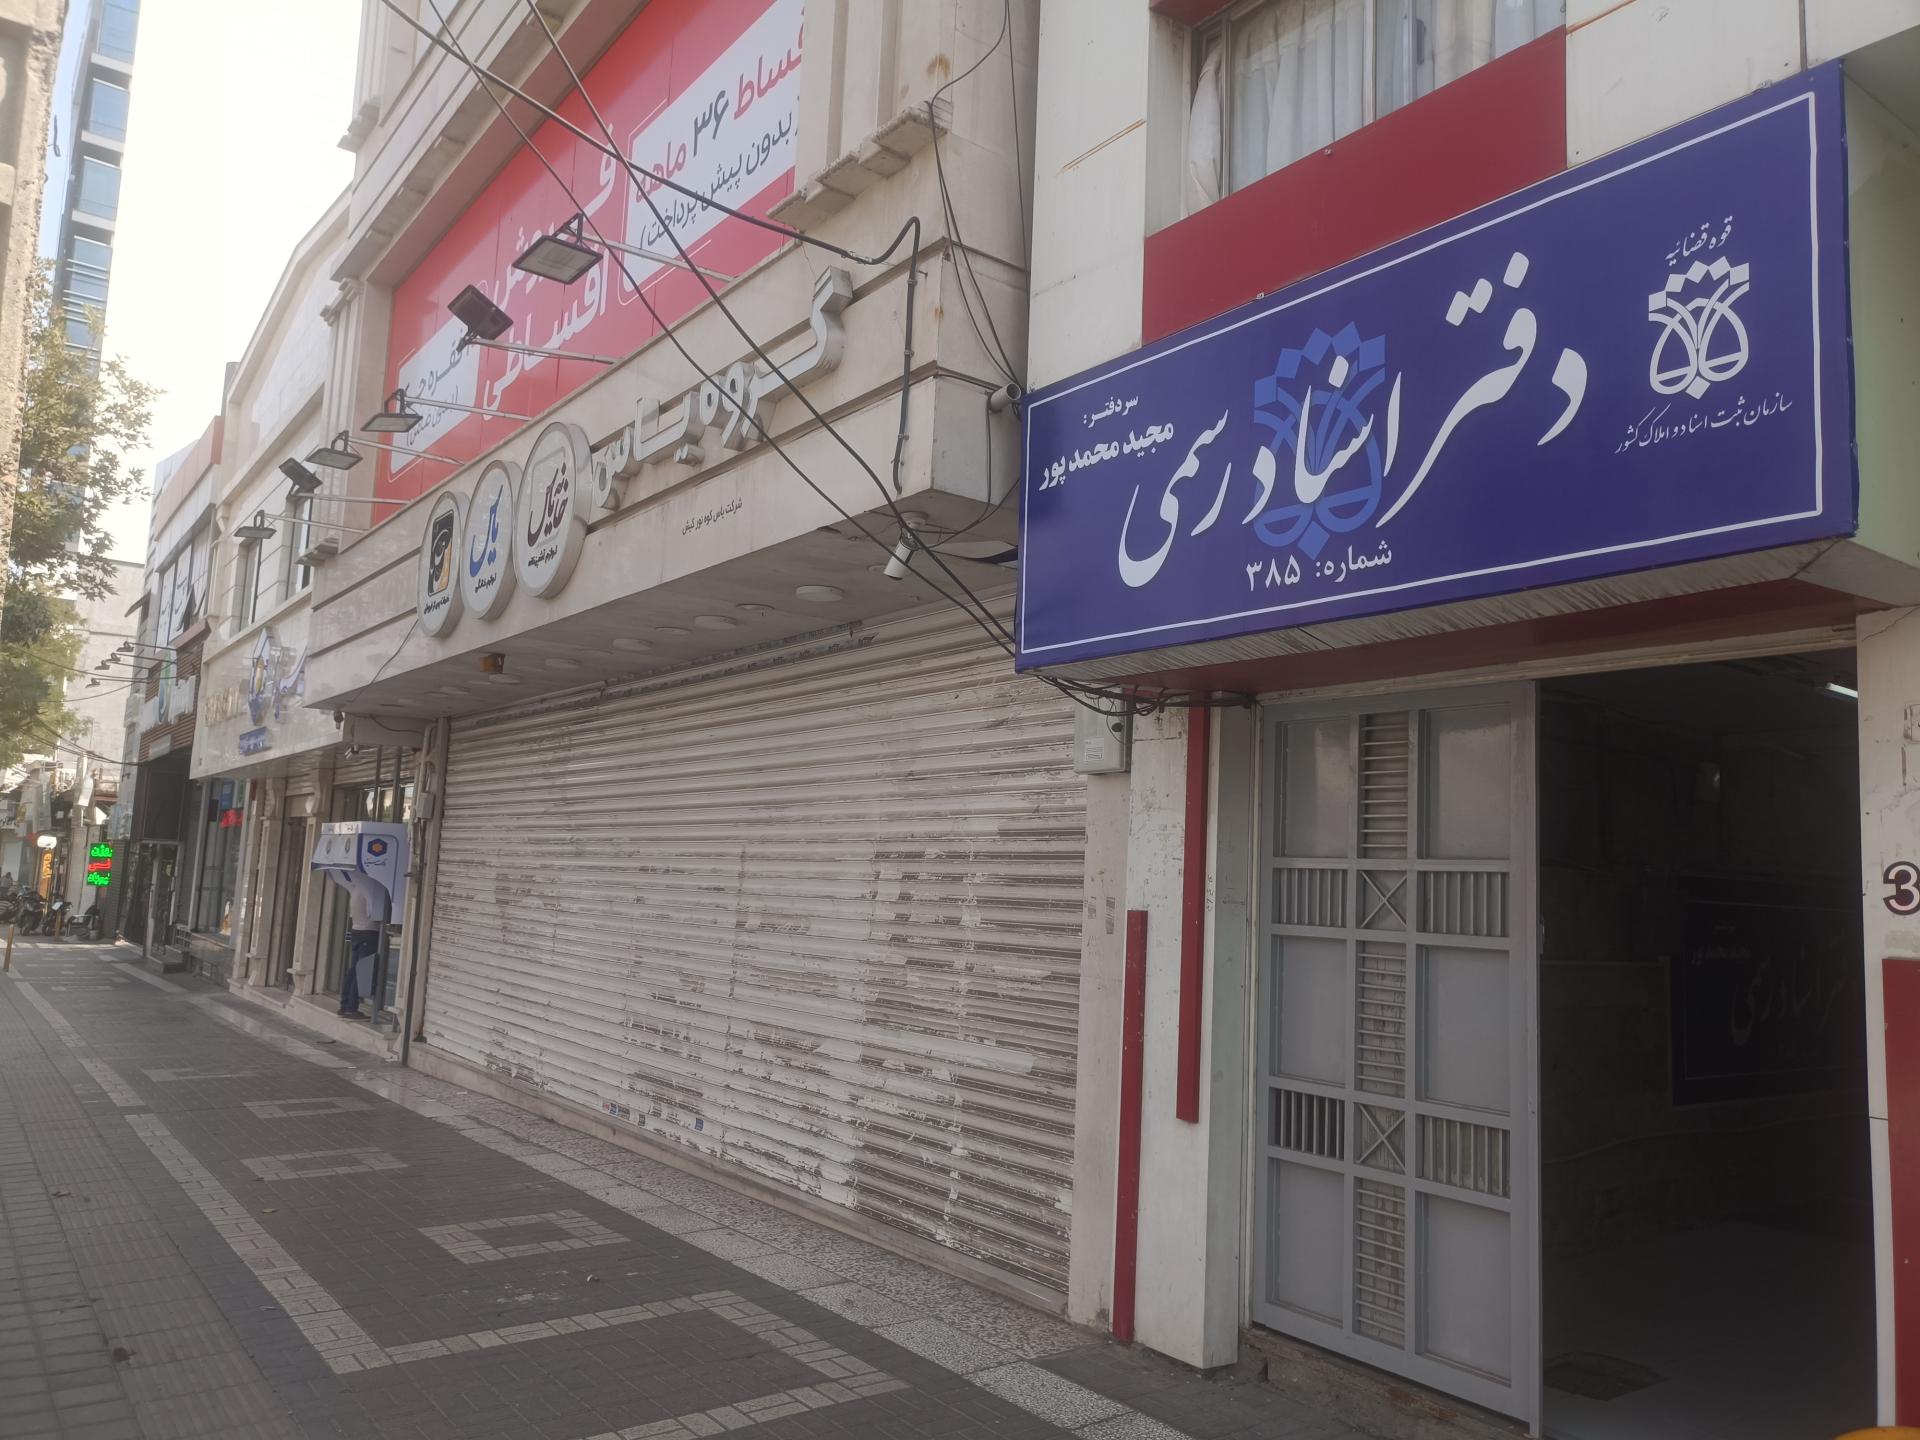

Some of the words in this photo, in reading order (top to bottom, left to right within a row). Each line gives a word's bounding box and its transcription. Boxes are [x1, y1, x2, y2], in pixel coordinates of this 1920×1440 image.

[693, 90, 729, 156] ۳۶
[746, 104, 797, 175] بدون
[701, 153, 742, 211] پیش
[1709, 216, 1733, 249] قوه
[484, 245, 610, 421] اقساطی
[701, 265, 852, 451] گروه
[1377, 251, 1588, 528] دفتر
[1711, 395, 1745, 427] ثبت
[1743, 392, 1793, 425] سازمان
[1123, 422, 1174, 458] مجید
[1242, 355, 1401, 525] اسناد
[1615, 407, 1657, 454] کشور
[1639, 403, 1672, 447] املاک
[1672, 427, 1680, 438] و
[1681, 414, 1708, 436] اسناد
[594, 390, 704, 511] یاس
[703, 509, 713, 525] کوه
[713, 506, 726, 522] یاس
[726, 497, 743, 514] شرکت
[1119, 409, 1232, 588] رسمی
[1246, 555, 1301, 591] ۳۸۵
[1315, 540, 1392, 582] شماره:
